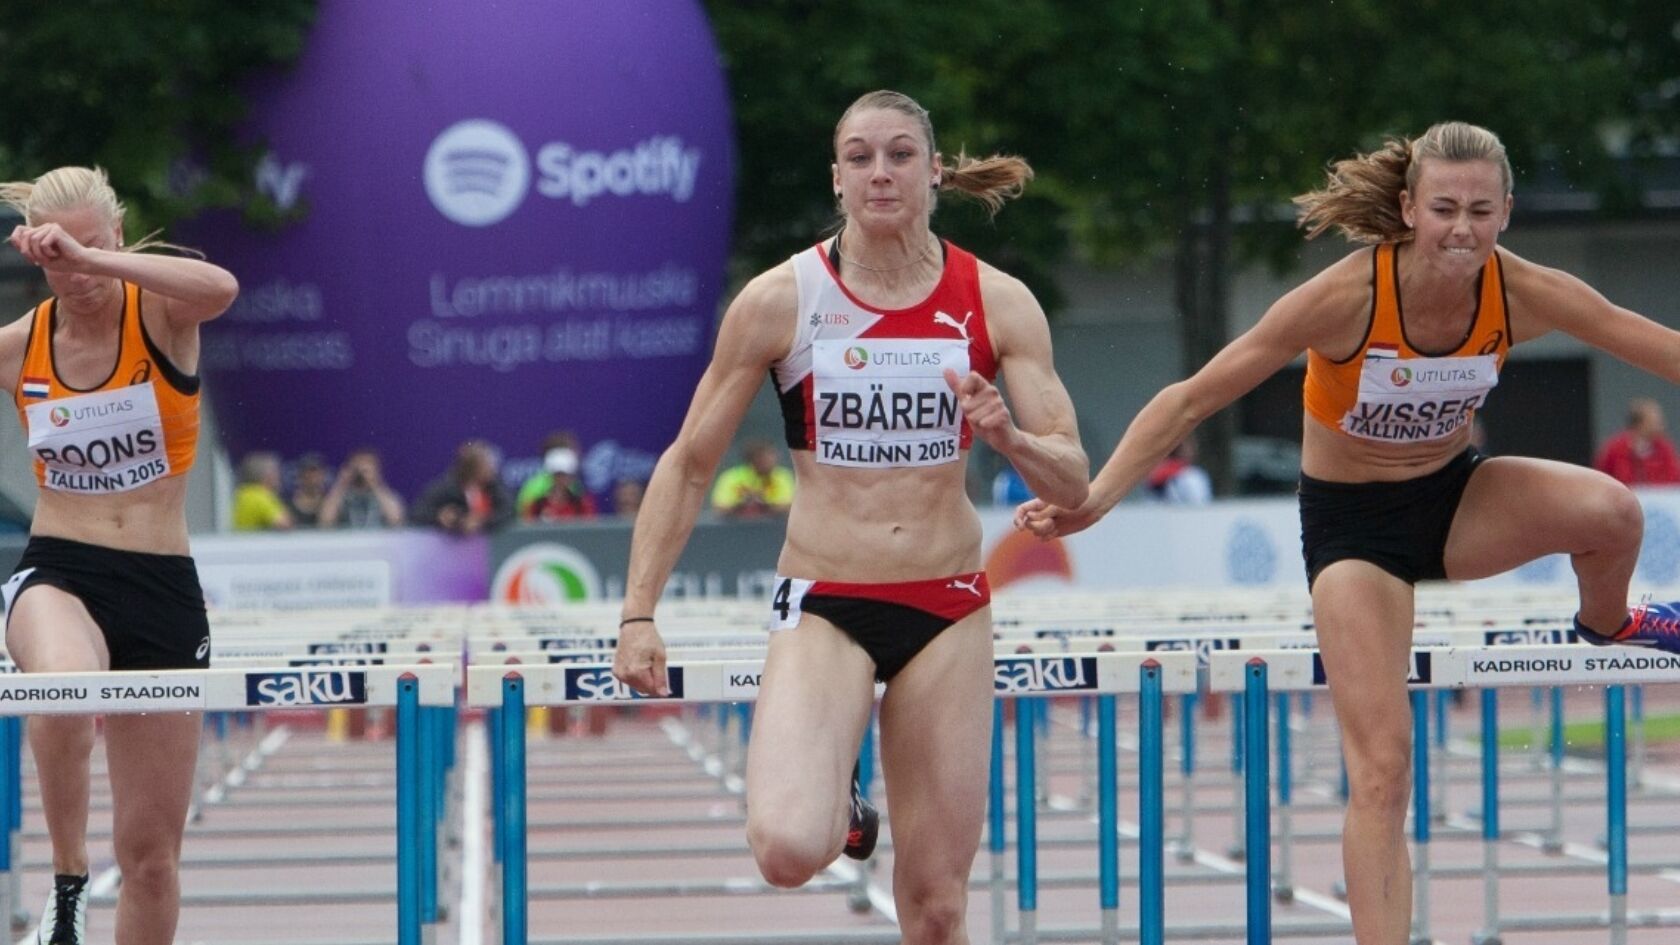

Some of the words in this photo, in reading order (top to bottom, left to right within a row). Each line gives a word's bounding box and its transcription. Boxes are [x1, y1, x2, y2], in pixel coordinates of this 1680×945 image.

[536, 134, 700, 206] Spotify
[824, 313, 849, 325] UBS
[873, 352, 941, 366] UTILITAS
[1416, 369, 1476, 383] UTILITAS
[74, 400, 133, 420] UTILITAS
[819, 384, 958, 431] ZBÄREN
[1350, 415, 1431, 440] TALLINN
[820, 440, 911, 463] TALLINN
[918, 439, 955, 461] 2015
[50, 469, 124, 490] TALLINN
[130, 458, 165, 485] 2015
[773, 578, 792, 621] 4
[994, 657, 1087, 692] saku
[1474, 659, 1572, 673] KADRIORU
[1585, 656, 1680, 671] STAADION
[100, 686, 200, 700] STAADION
[257, 672, 354, 706] saku
